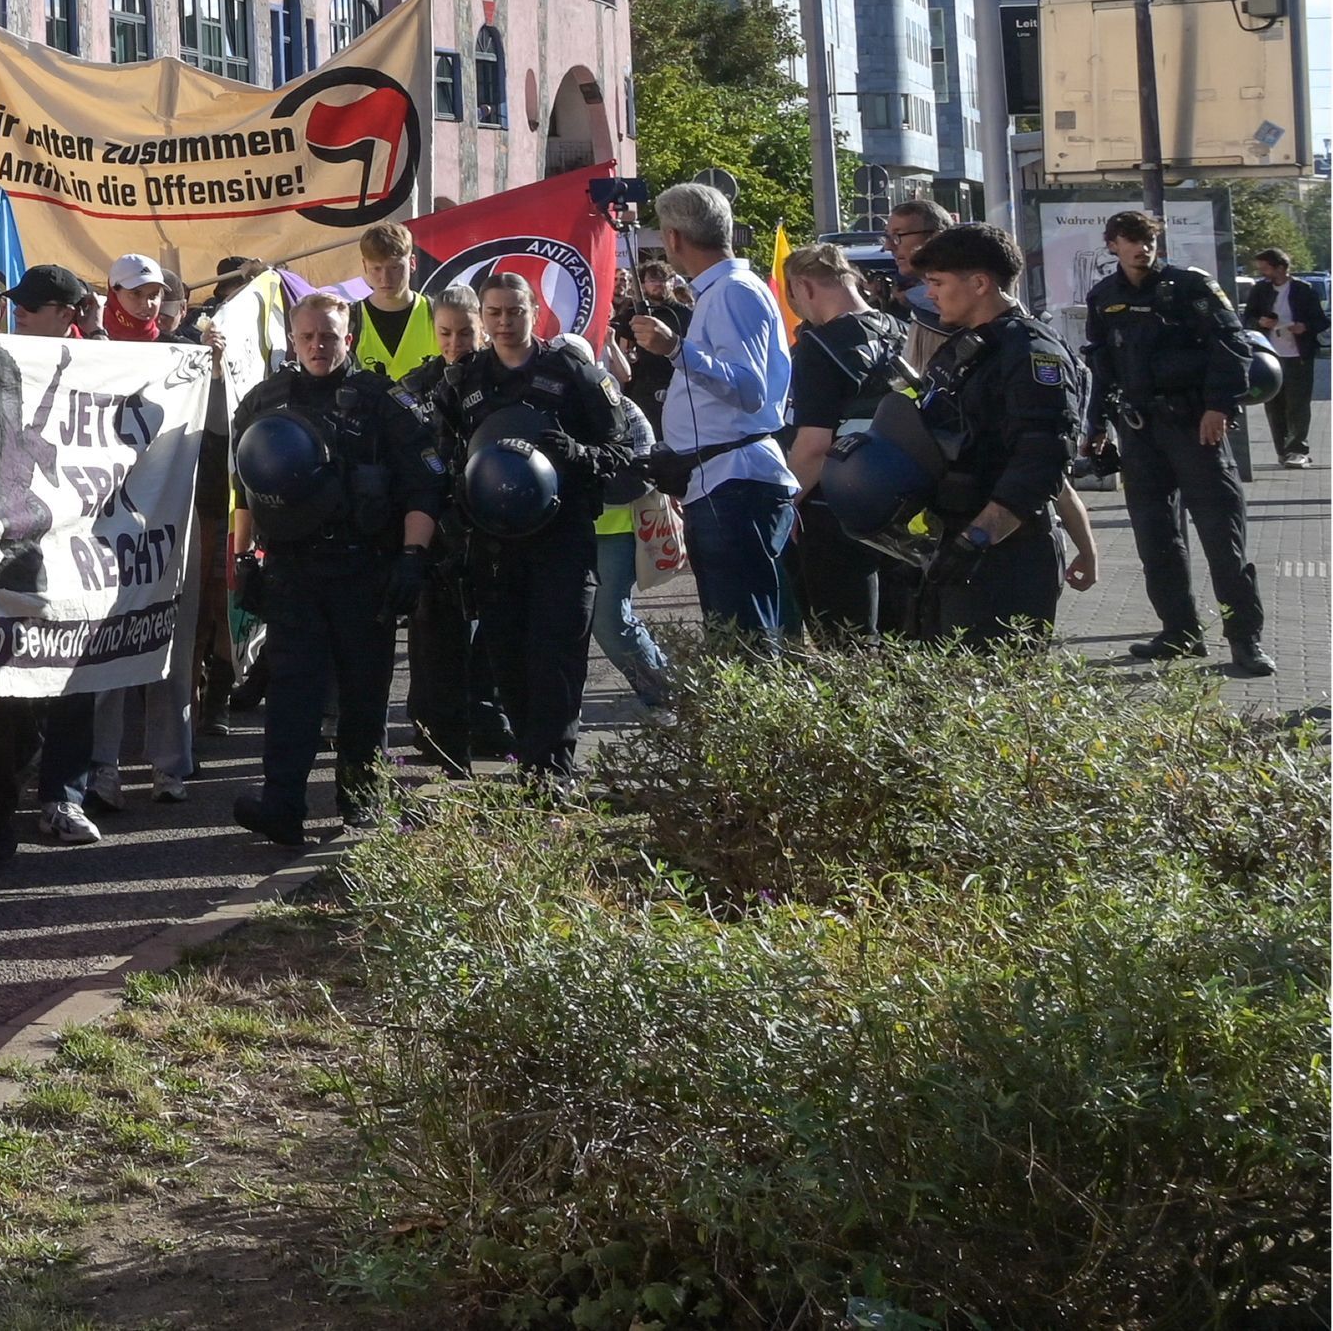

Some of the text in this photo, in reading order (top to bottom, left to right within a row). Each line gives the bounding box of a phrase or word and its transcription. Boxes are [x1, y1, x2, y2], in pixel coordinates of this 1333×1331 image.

[101, 126, 296, 165] zusammen
[70, 171, 93, 204] in
[97, 175, 137, 207] die
[144, 165, 305, 207] Offensive!
[59, 389, 151, 448] JETZT
[11, 621, 90, 659] Gewalt
[88, 617, 125, 656] und
